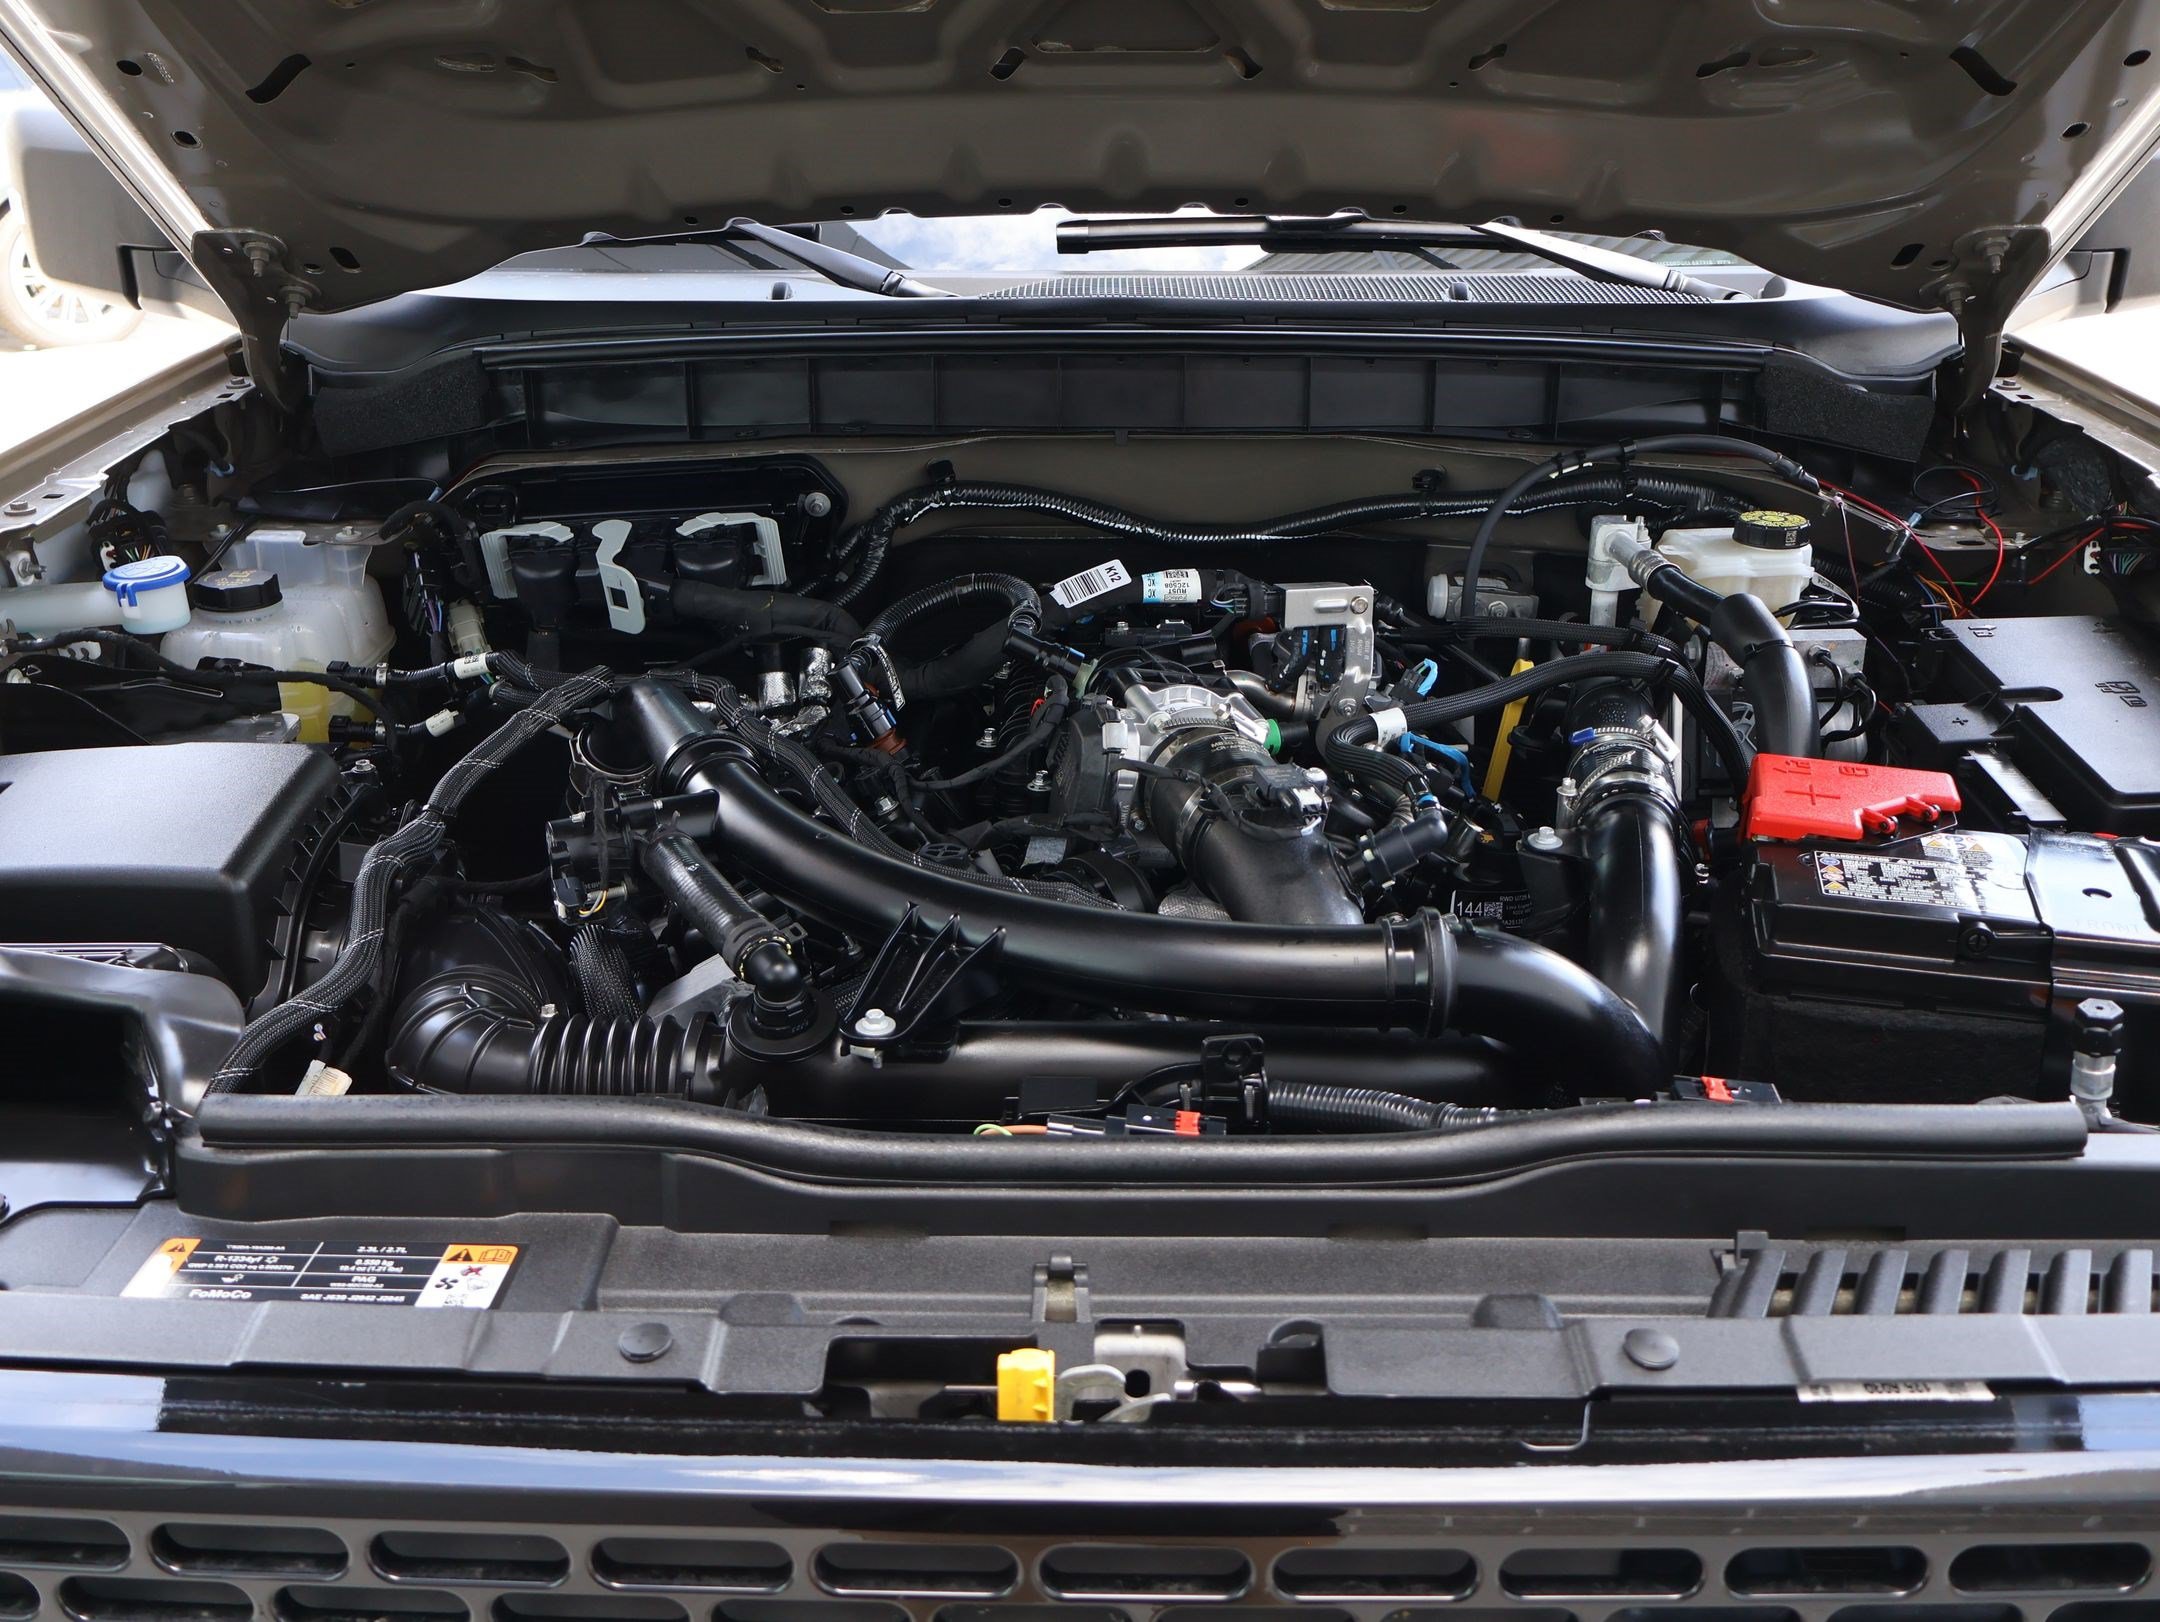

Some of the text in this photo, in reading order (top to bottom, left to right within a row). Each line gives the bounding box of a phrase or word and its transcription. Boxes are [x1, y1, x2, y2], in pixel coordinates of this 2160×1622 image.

[1105, 565, 1122, 583] K12
[1457, 901, 1482, 916] 144
[351, 1275, 377, 1283] PAG
[189, 1289, 252, 1299] FoMoCo
